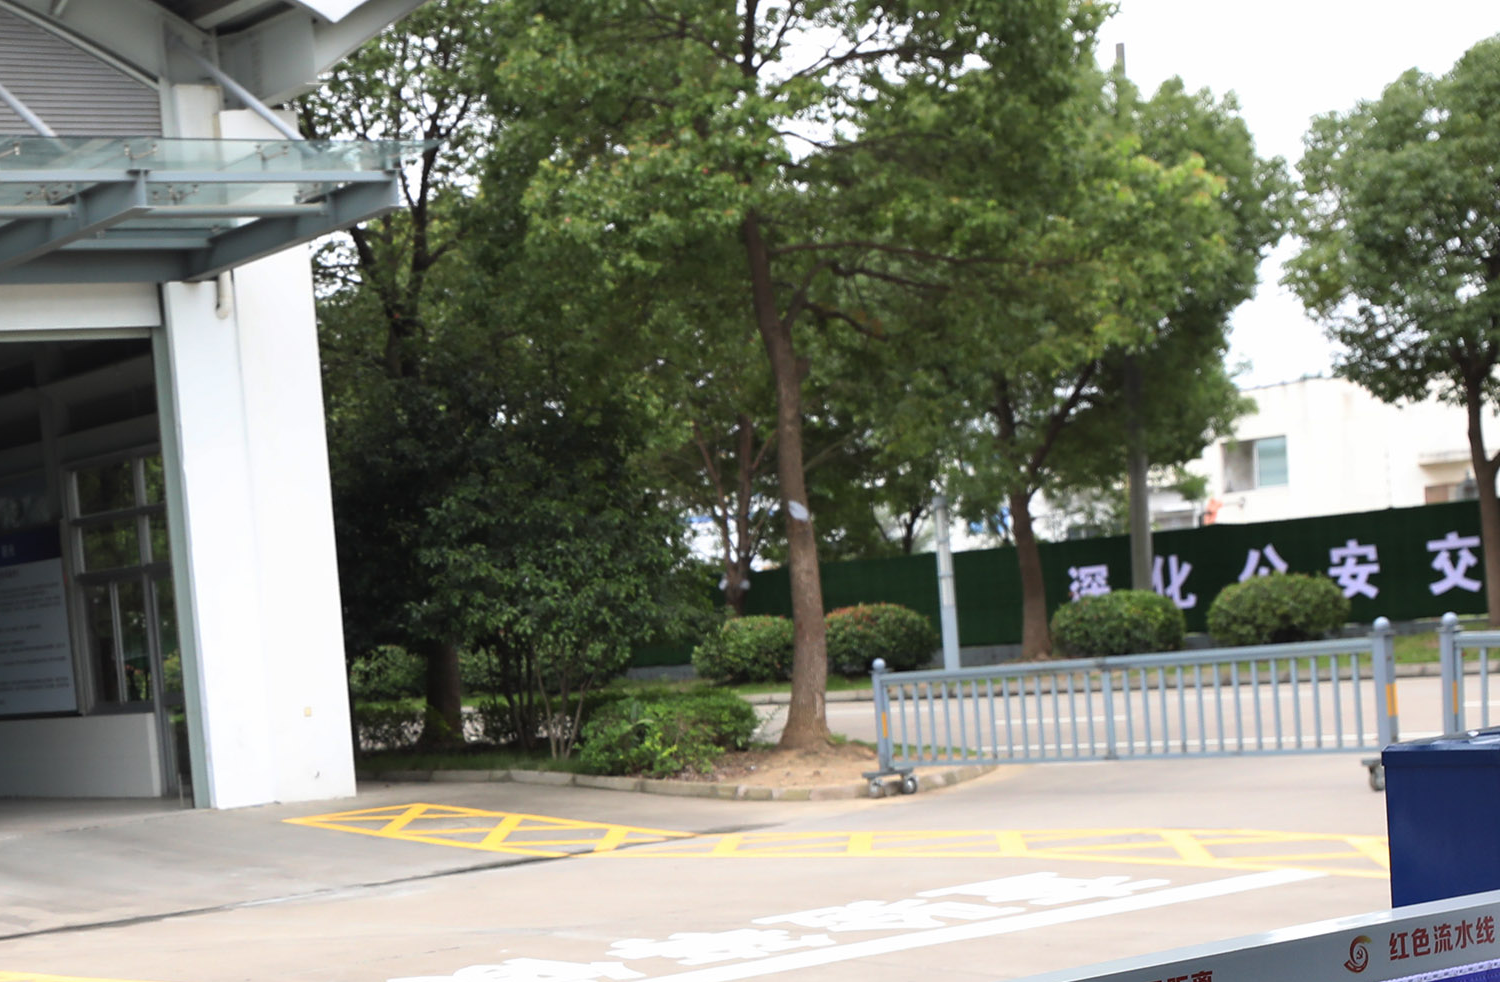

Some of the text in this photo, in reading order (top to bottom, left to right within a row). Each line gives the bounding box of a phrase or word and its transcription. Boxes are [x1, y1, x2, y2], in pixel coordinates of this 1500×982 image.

[1389, 915, 1496, 961] 红色流水线
